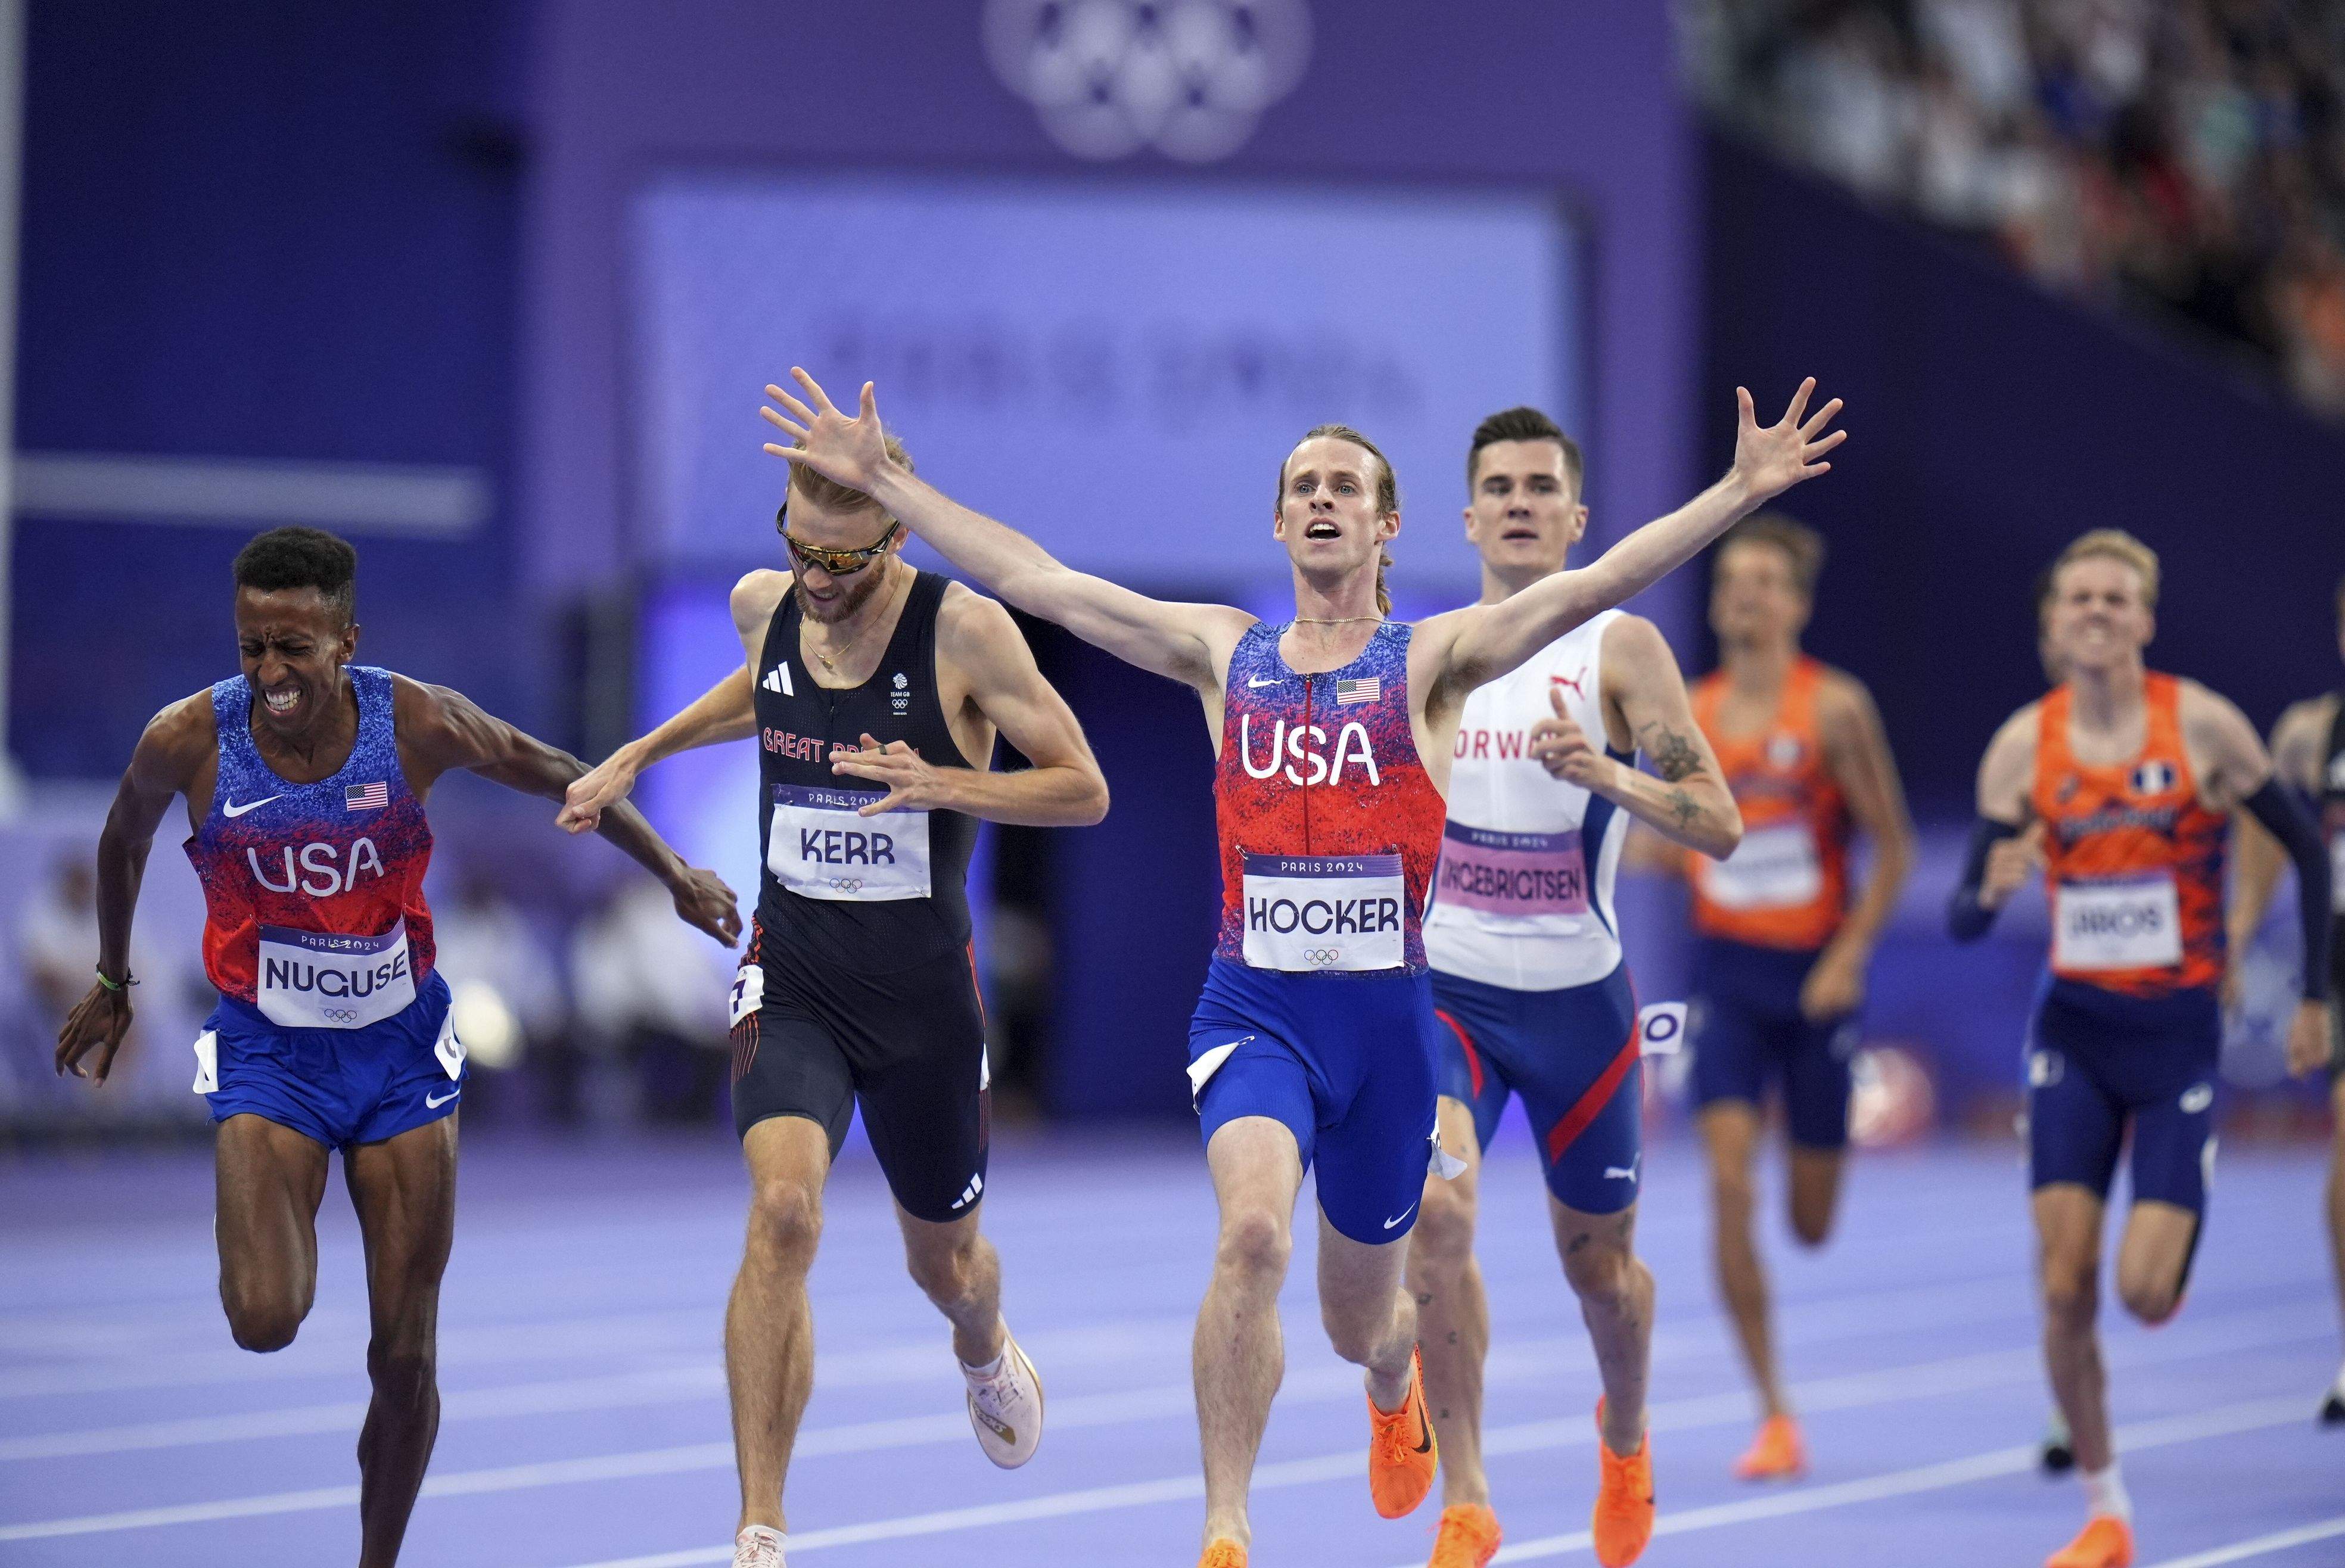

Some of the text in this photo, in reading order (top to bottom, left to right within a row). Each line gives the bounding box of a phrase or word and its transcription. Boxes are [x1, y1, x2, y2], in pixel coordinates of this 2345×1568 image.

[763, 727, 824, 763] GREAT
[1242, 713, 1380, 786] USA
[850, 796, 881, 805] 202
[801, 827, 895, 864] KERR
[247, 837, 384, 897] USA
[1326, 862, 1363, 872] 2024
[1249, 897, 1399, 935] HOCKER
[345, 939, 379, 950] 2024
[266, 949, 406, 998] NUGUSE
